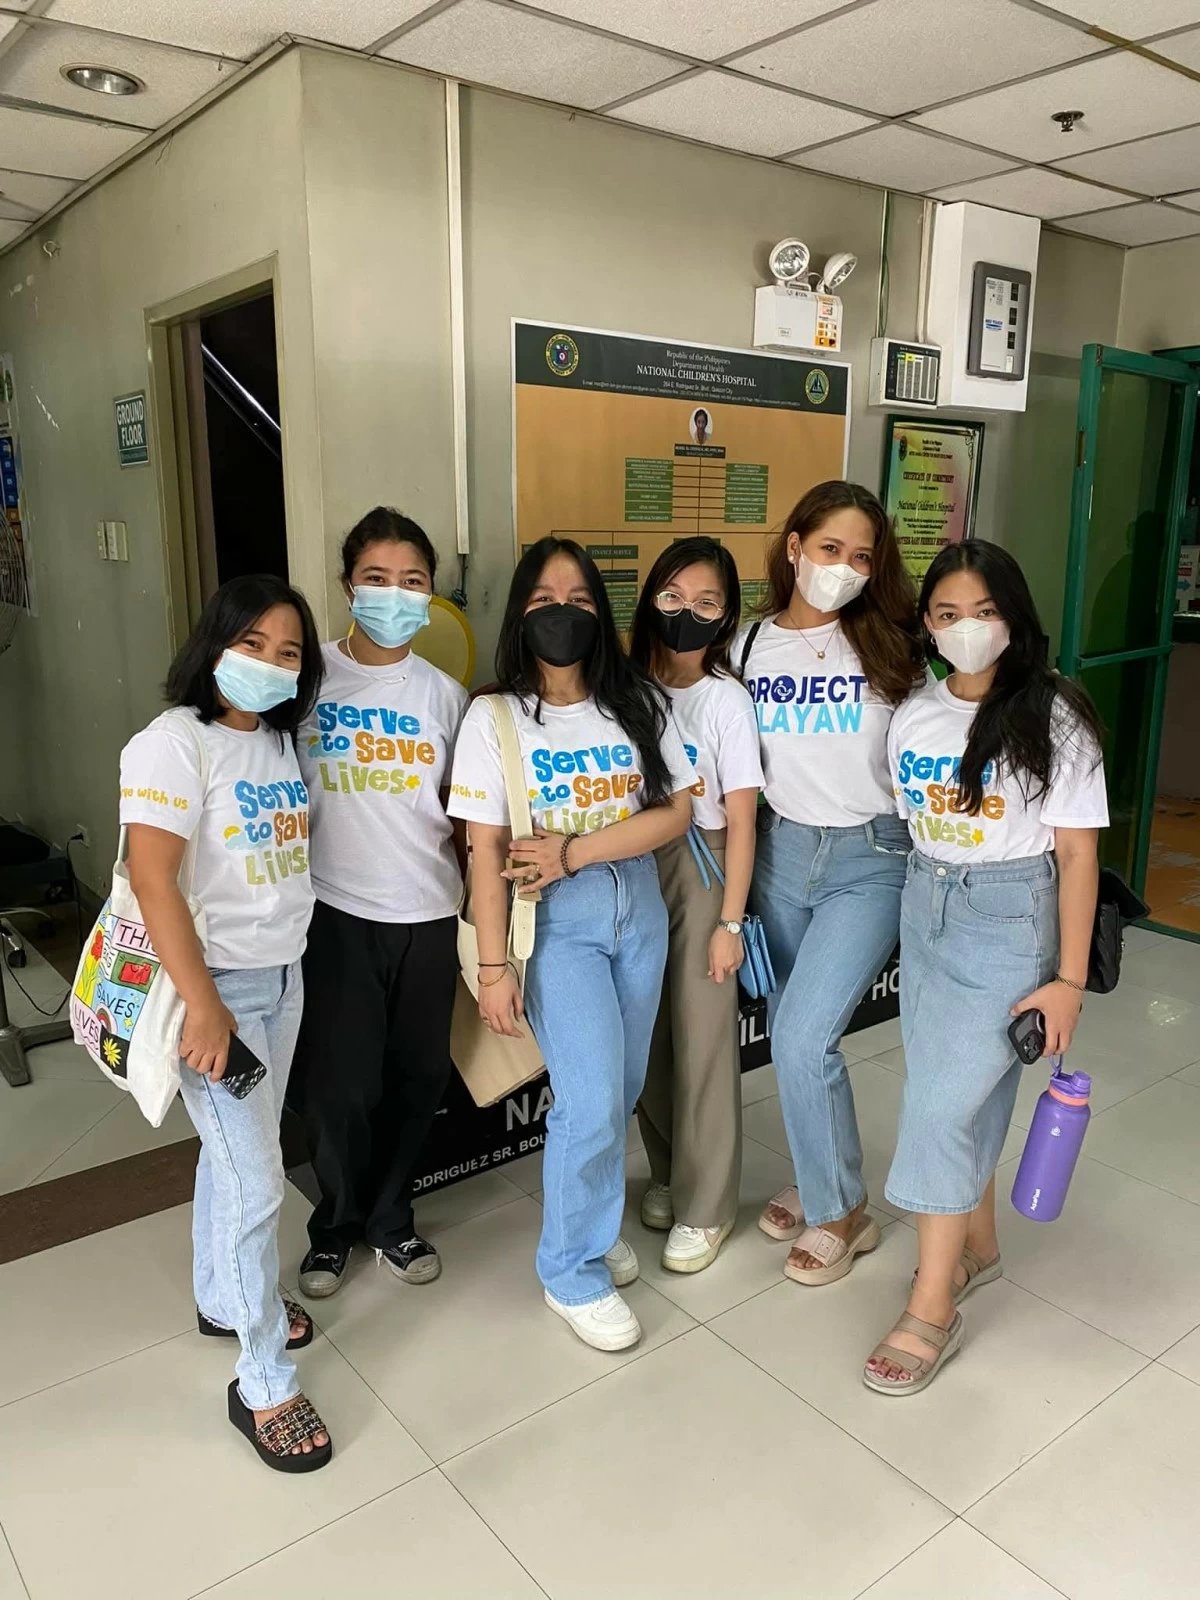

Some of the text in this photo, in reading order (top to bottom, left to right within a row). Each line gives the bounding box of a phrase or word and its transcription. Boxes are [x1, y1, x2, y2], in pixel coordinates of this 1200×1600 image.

[666, 350, 687, 360] Republic
[704, 355, 730, 364] Philippines
[673, 359, 701, 369] Department
[637, 364, 756, 387] NATIONAL CHILDREN'S HOSPITAL
[117, 400, 144, 425] GROUND
[121, 424, 144, 446] FLOOR
[748, 675, 867, 704] PROJECT
[317, 702, 420, 735] Serve
[756, 703, 864, 733] LAYAW
[321, 731, 436, 764] to Save
[532, 744, 633, 782] Serve
[319, 762, 406, 794] Lives
[541, 774, 642, 808] to Save
[137, 788, 168, 805] with
[173, 797, 188, 810] us
[234, 780, 308, 819] Serve
[475, 790, 487, 800] us
[927, 784, 1005, 820] Sae
[245, 811, 308, 847] to Sav
[916, 811, 974, 848] ives
[97, 983, 135, 1018] SAVES
[74, 1004, 99, 1043] LIVES
[493, 1147, 515, 1162] SR.
